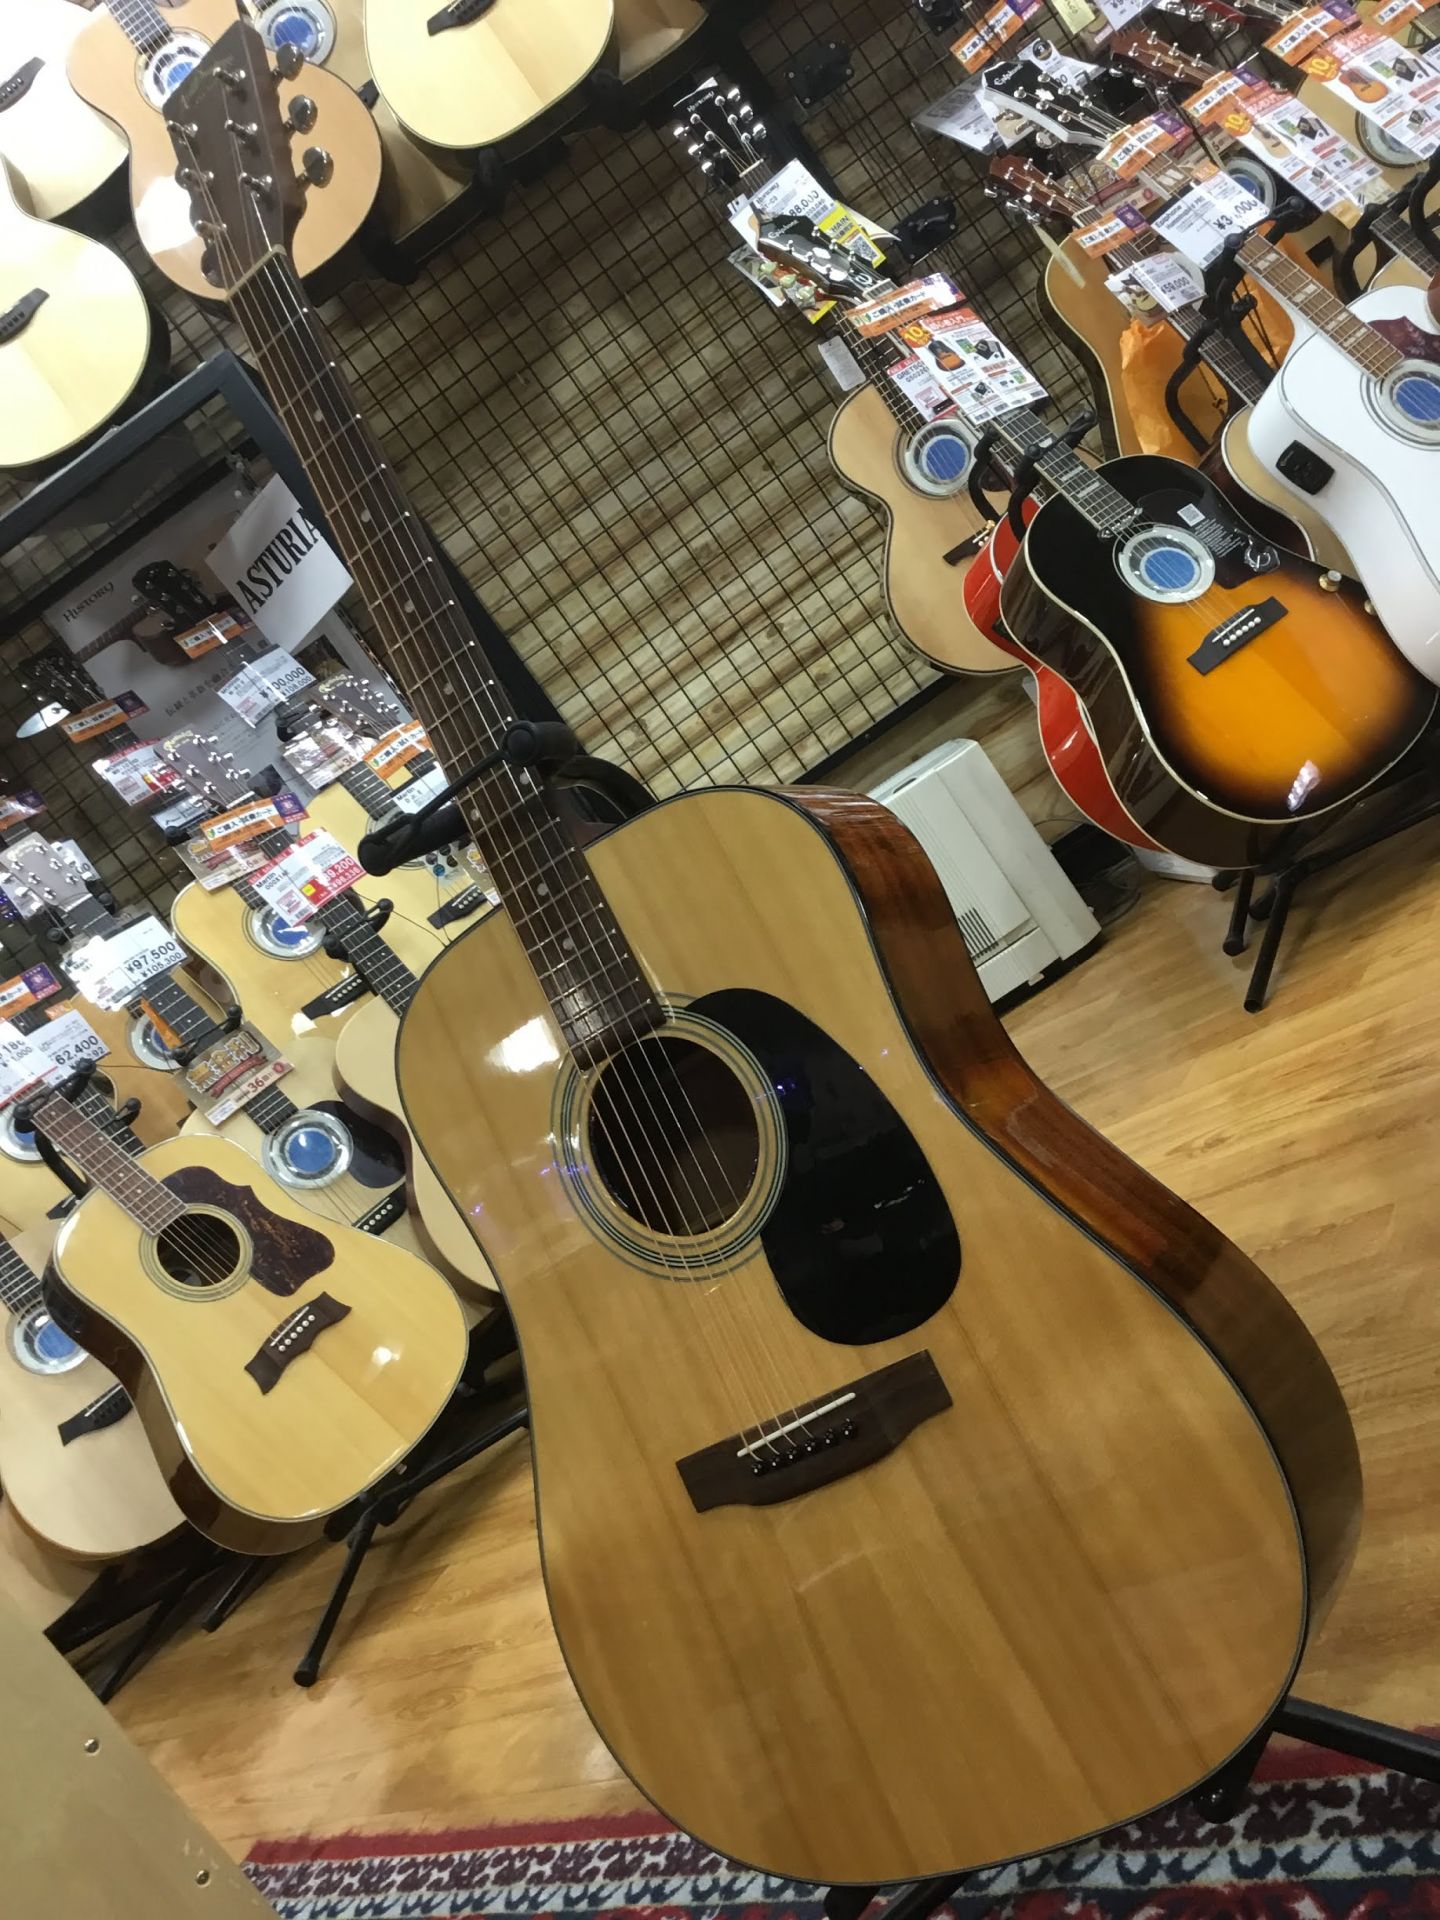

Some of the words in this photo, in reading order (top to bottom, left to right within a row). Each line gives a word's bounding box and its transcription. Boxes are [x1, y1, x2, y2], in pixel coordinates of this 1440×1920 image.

[235, 506, 319, 615] ASTURIA
[255, 871, 277, 889] Martin
[125, 941, 177, 974] ¥97,500
[140, 951, 182, 978] ¥105,300
